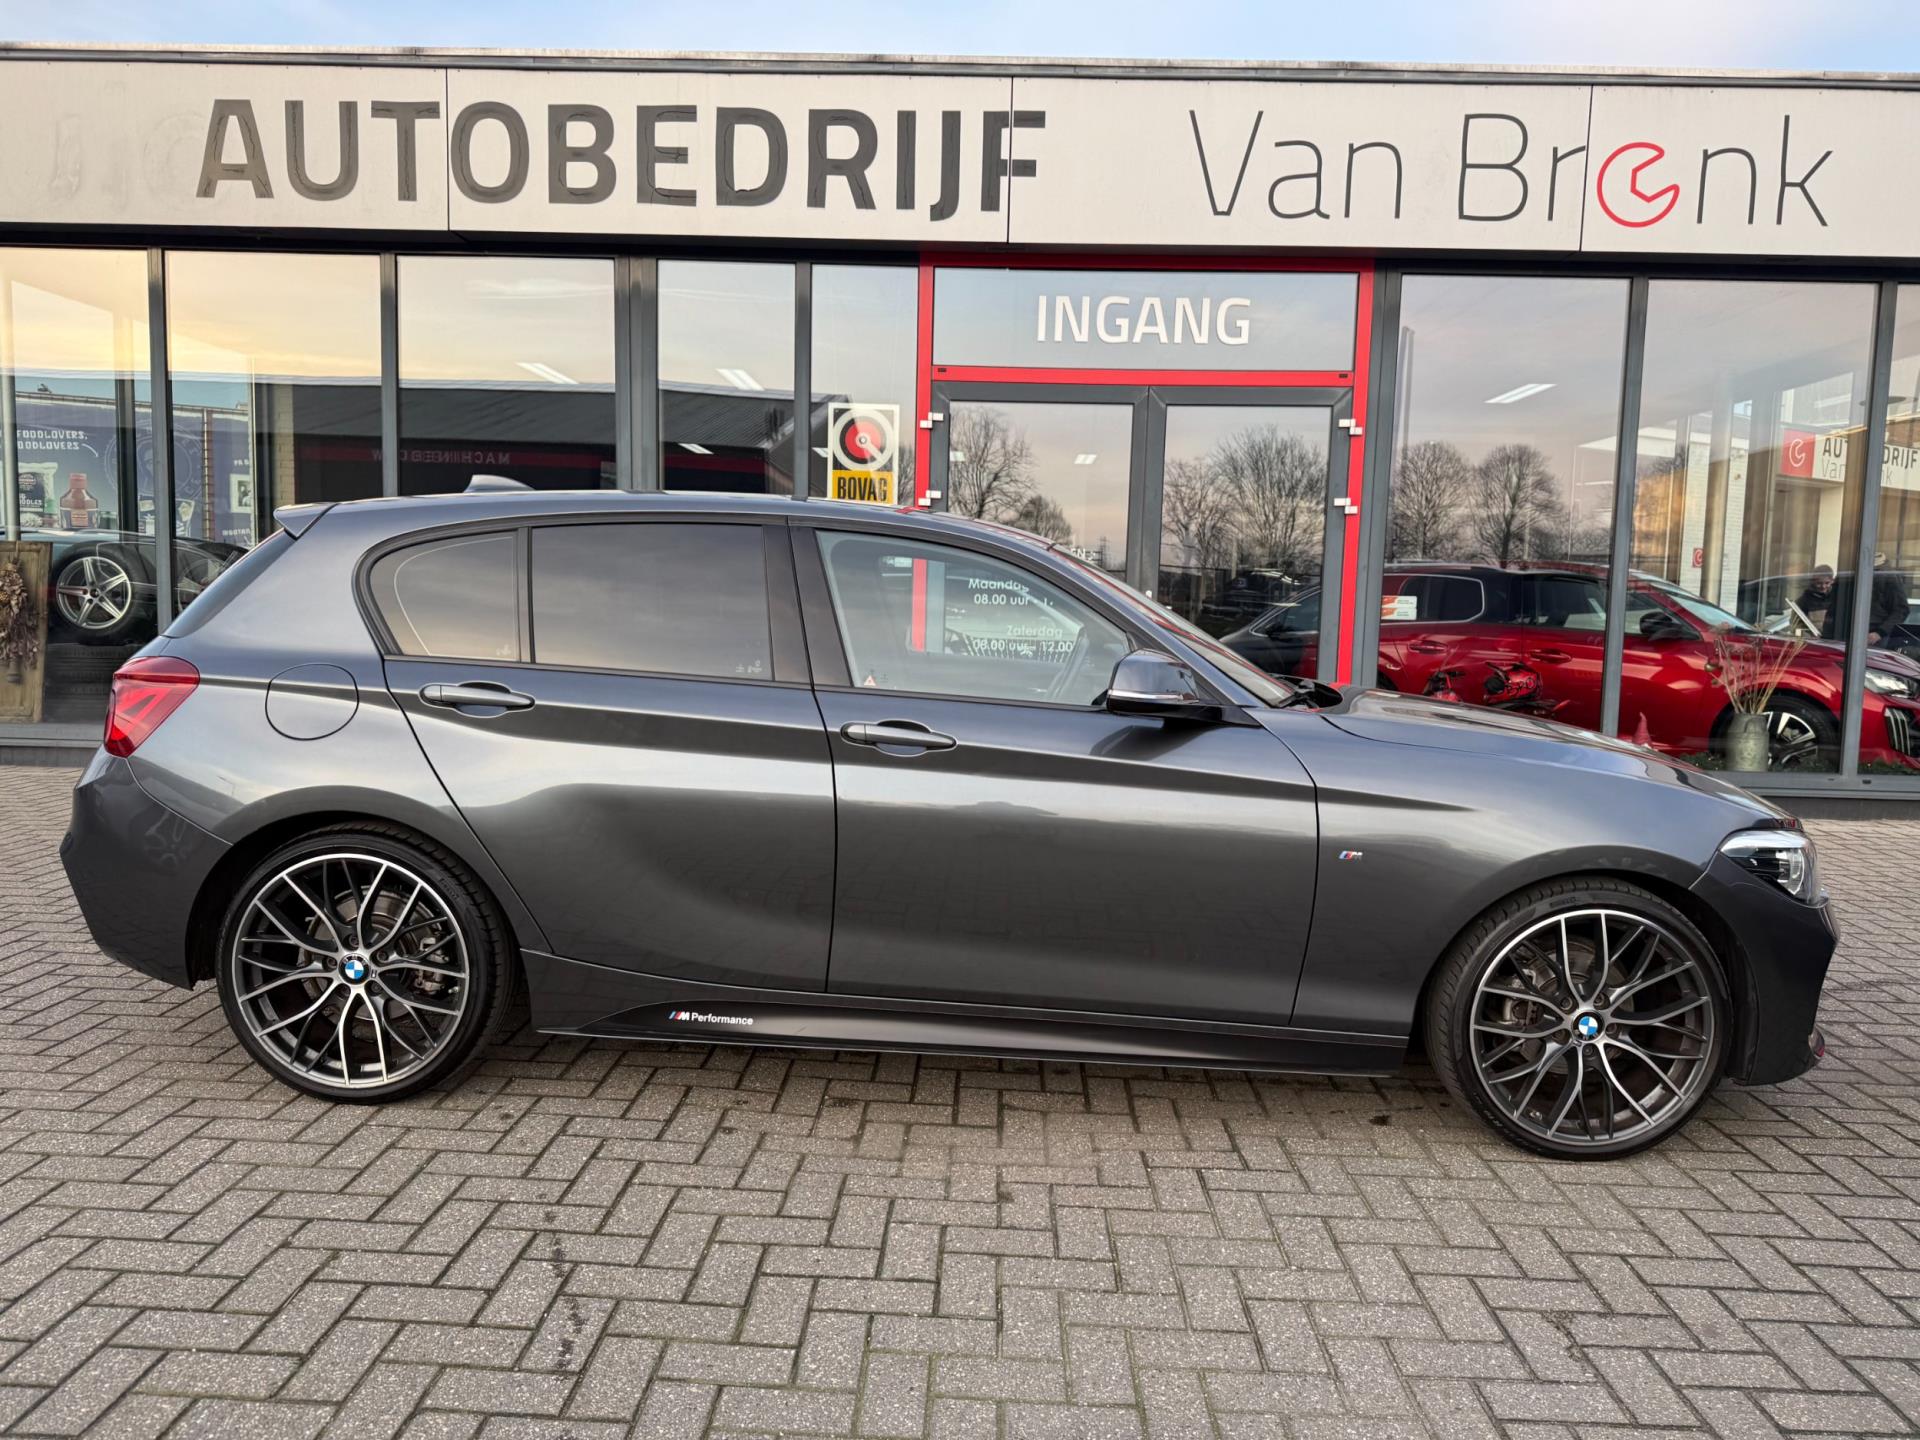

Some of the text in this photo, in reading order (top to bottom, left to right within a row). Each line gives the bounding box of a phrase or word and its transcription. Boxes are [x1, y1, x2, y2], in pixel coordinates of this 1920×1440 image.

[195, 98, 1046, 222] AUTOBEDRIJF
[1189, 109, 1403, 220] Van
[1036, 294, 1252, 346] INGANG
[837, 476, 888, 502] BOVAG
[974, 594, 1007, 605] 08.00
[691, 1012, 754, 1025] Performance
